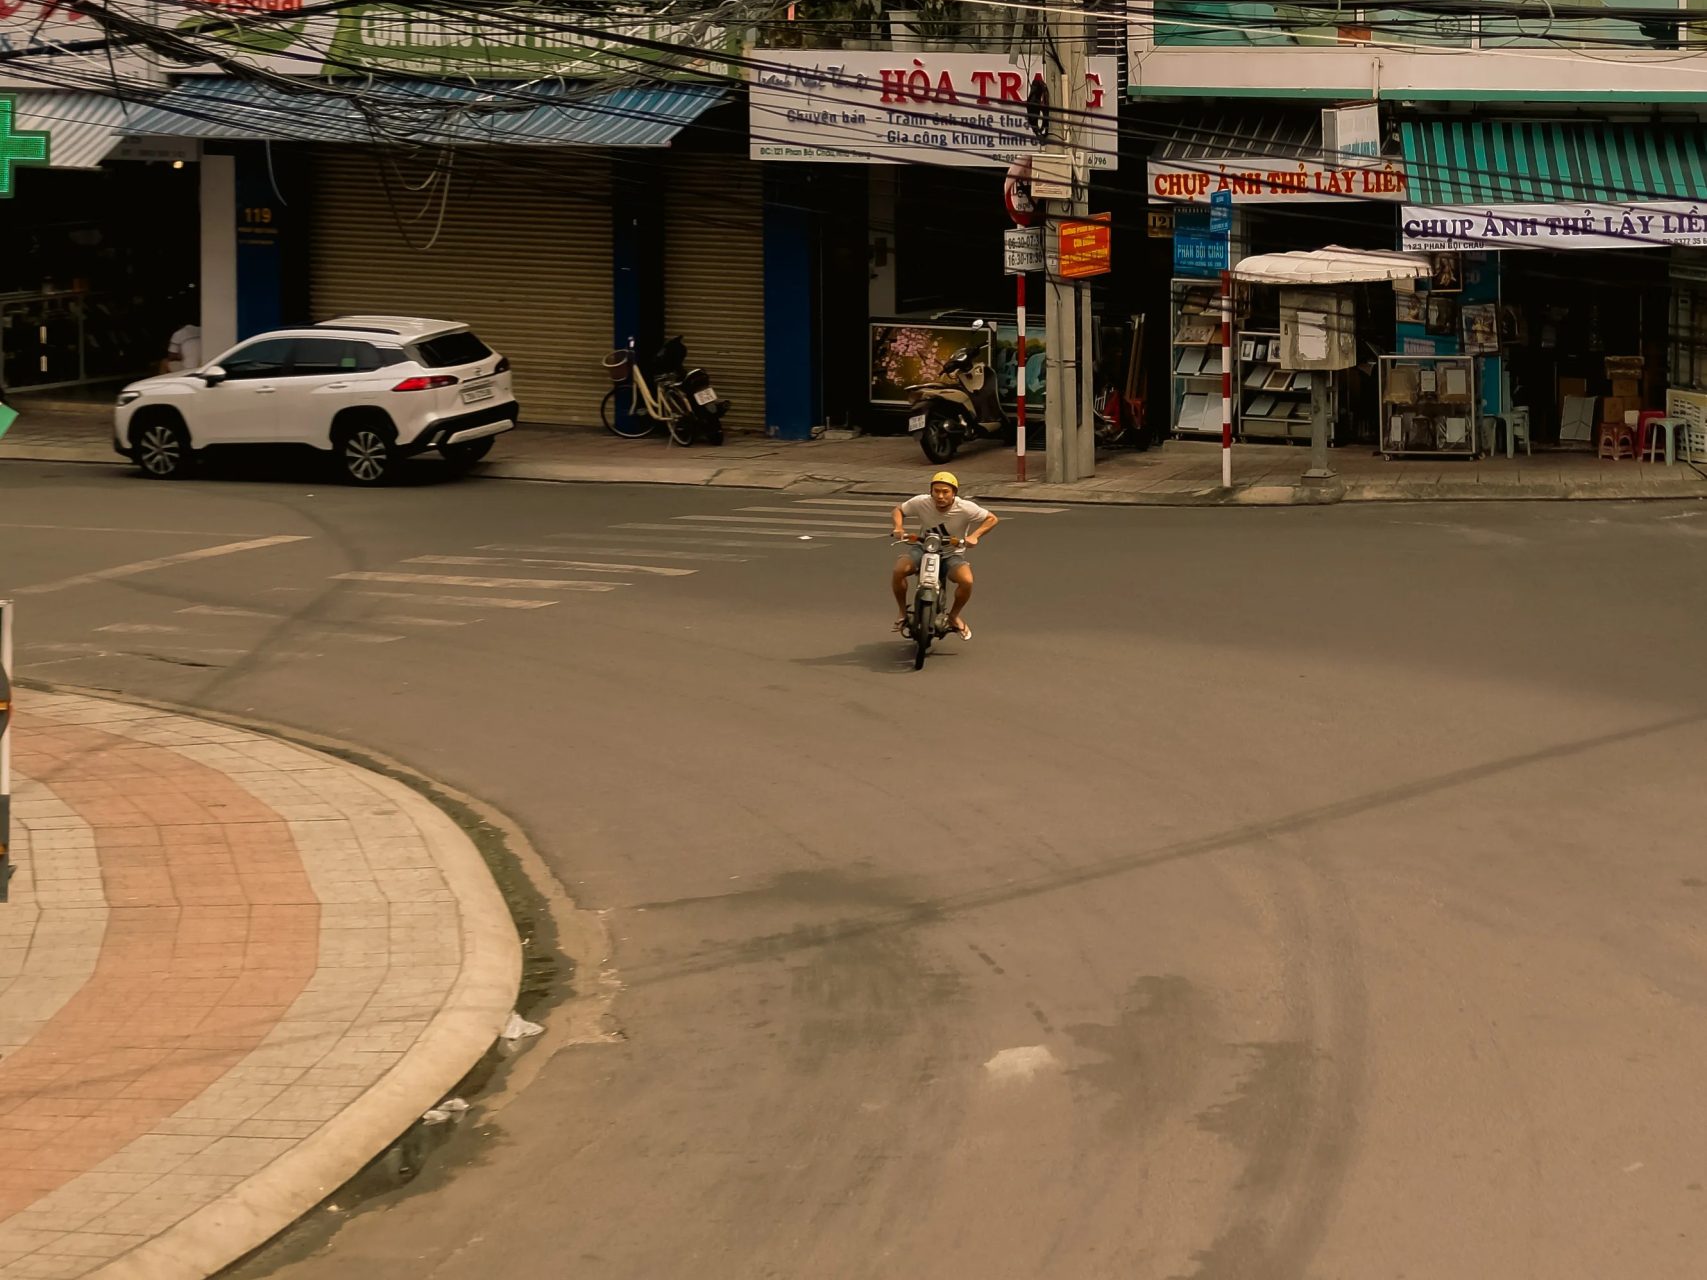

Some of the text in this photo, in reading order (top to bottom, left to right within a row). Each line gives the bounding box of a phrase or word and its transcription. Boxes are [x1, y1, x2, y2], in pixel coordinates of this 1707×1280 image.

[879, 58, 960, 104] HÒA
[887, 130, 909, 144] Gia
[913, 130, 948, 147] công
[952, 130, 995, 148] khung
[1154, 173, 1211, 203] CHỤP
[1266, 163, 1309, 195] THẺ
[245, 207, 272, 223] 119
[1403, 218, 1474, 243] CHỤP
[1482, 210, 1539, 237] ẢNH
[1541, 209, 1596, 236] THẺ
[1603, 207, 1655, 235] LẤY
[1177, 241, 1224, 261] PHAN BỘI CHÂU
[1407, 243, 1423, 251] 123
[1424, 243, 1446, 251] PHAN
